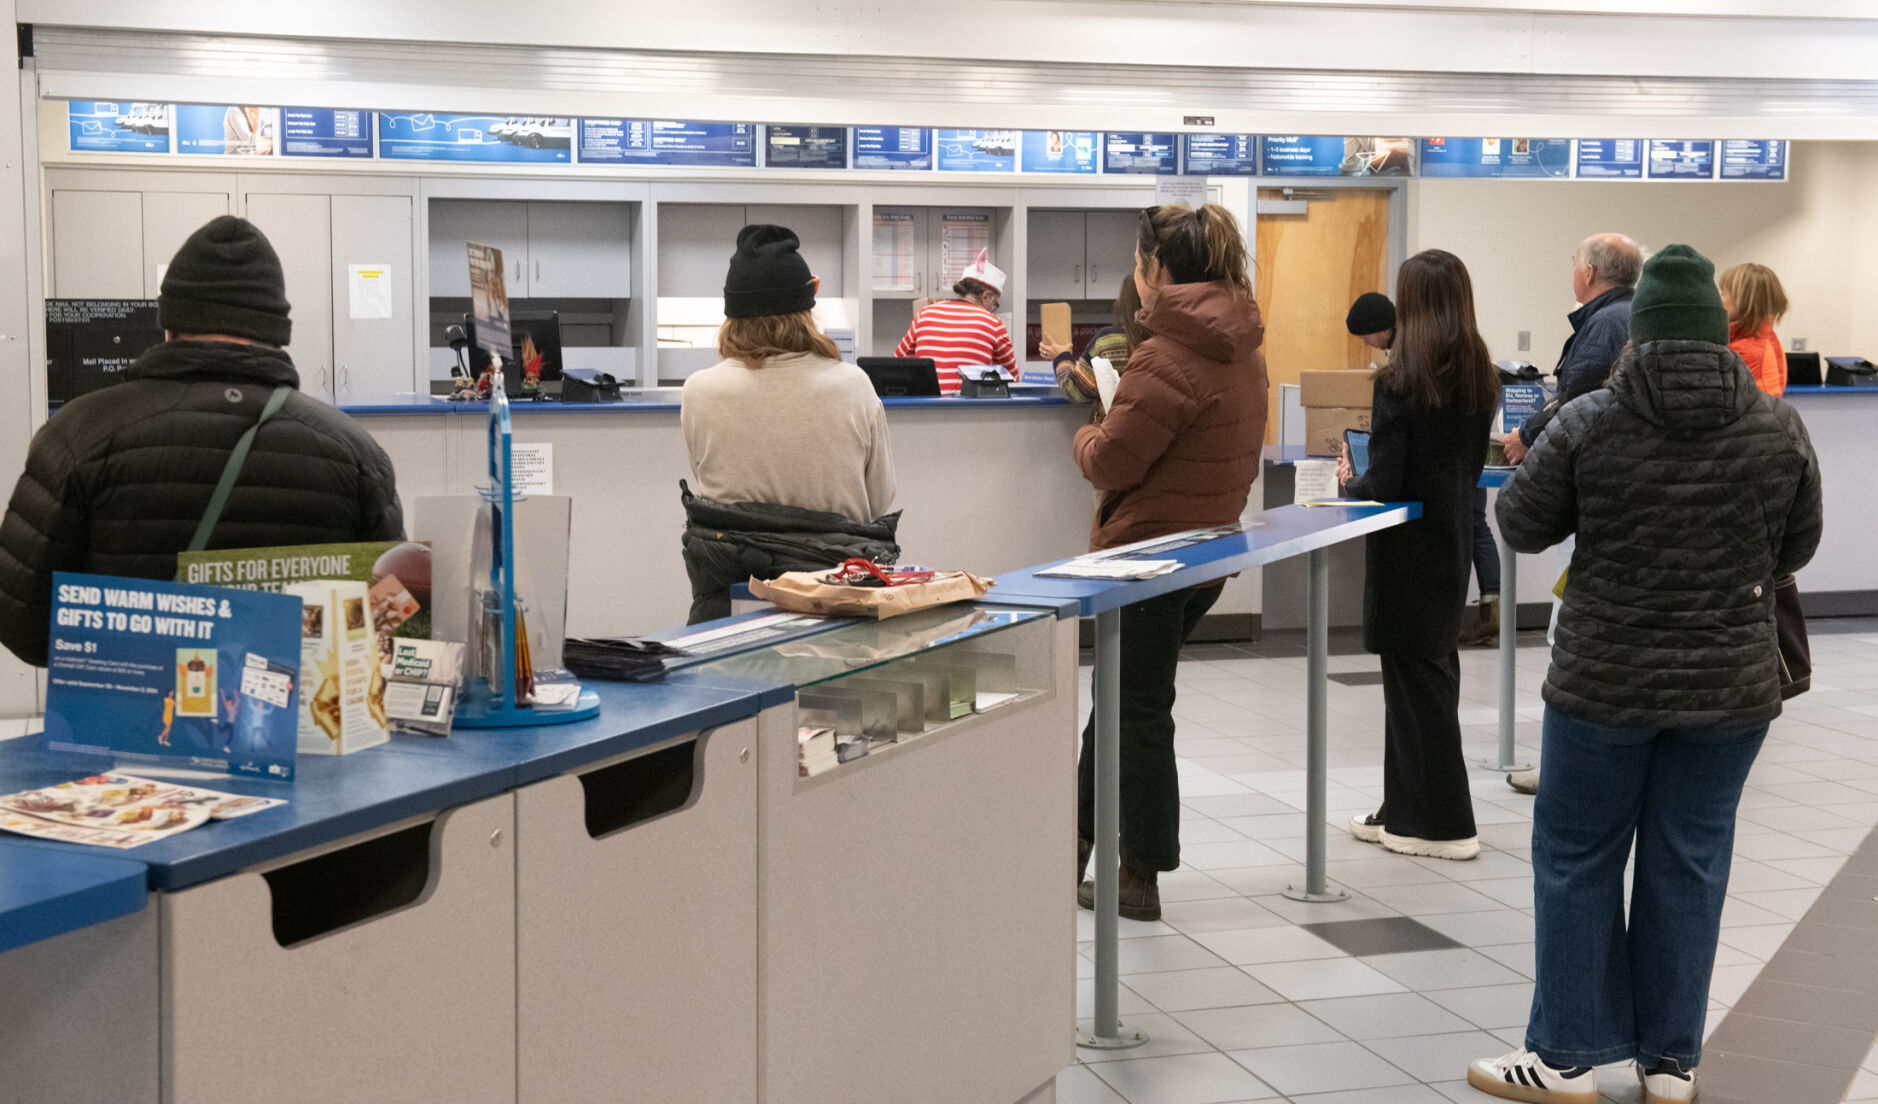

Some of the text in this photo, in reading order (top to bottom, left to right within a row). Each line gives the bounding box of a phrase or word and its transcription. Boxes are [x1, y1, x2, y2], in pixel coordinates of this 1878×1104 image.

[188, 554, 351, 584] GIFTS FOR EVERYONE
[58, 584, 232, 618] SEND WARM WISHES &
[56, 608, 214, 640] GIFTS TO GO WITH IT
[55, 638, 97, 653] Save $1
[398, 646, 416, 658] Lost
[396, 656, 431, 668] Medicaid
[394, 667, 428, 678] or CHIP?
